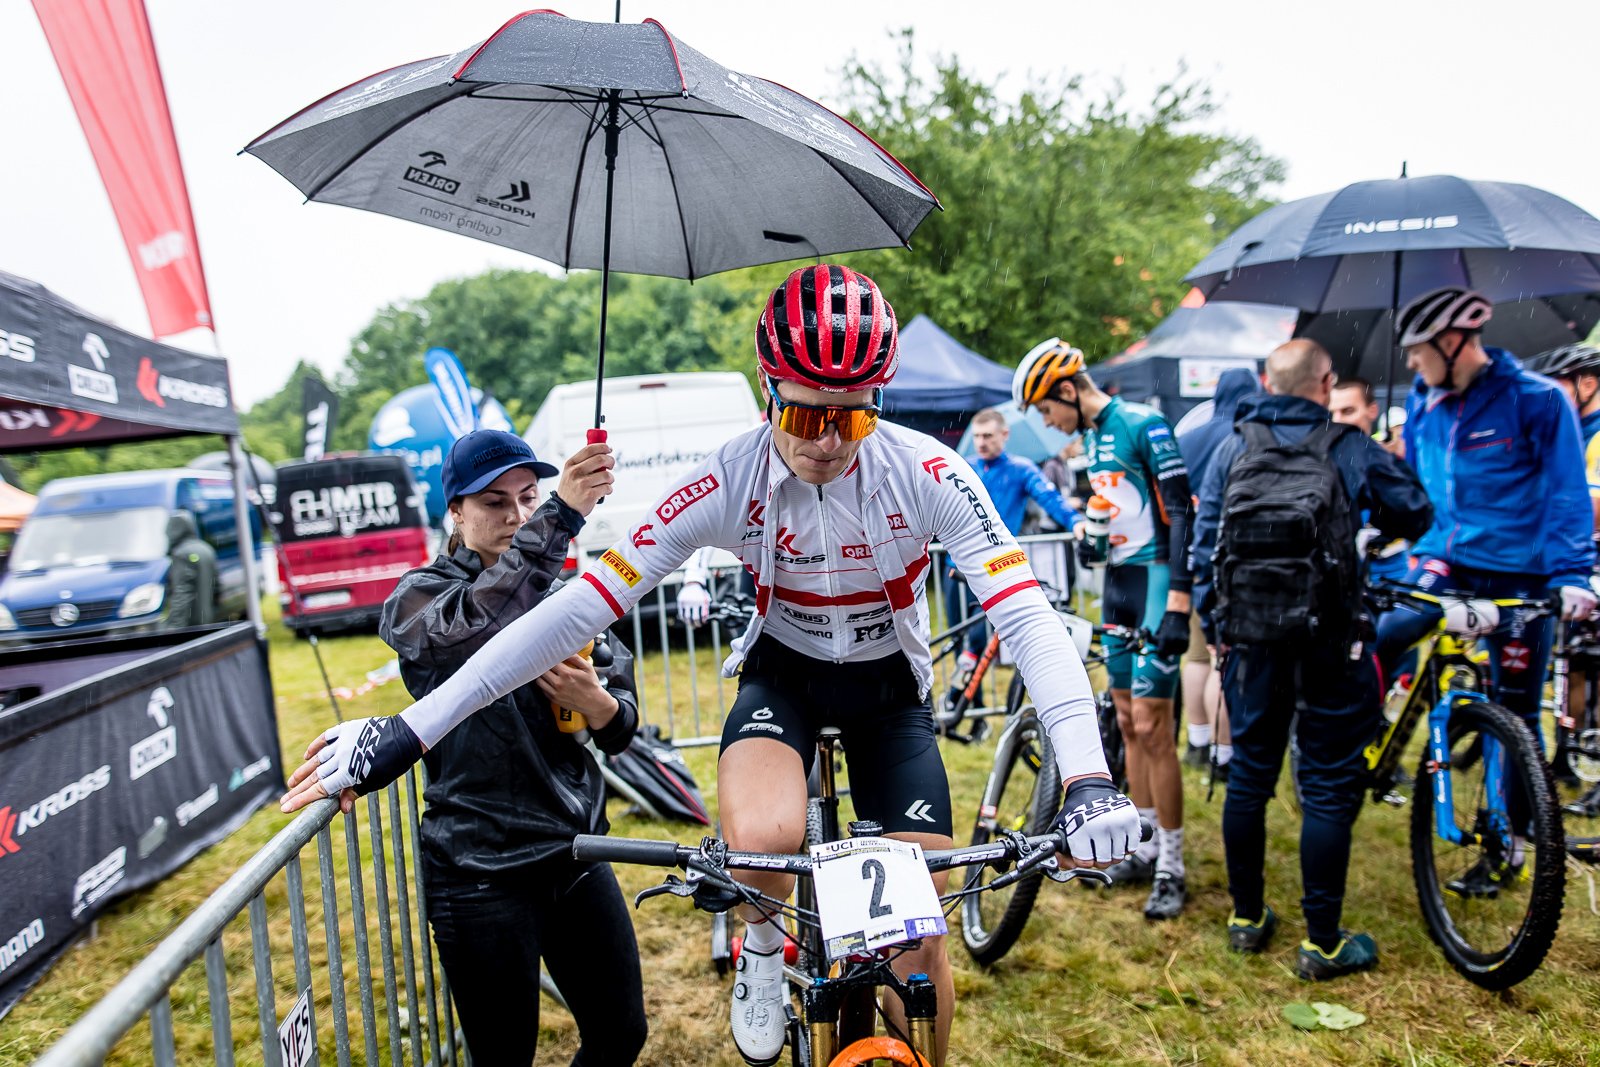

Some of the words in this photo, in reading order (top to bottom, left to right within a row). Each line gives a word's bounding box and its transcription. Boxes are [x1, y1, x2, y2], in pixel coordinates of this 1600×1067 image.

[1344, 215, 1459, 235] INESIS
[330, 481, 397, 512] MTB
[660, 478, 715, 519] ORLEN
[945, 472, 1003, 546] KROSS
[603, 550, 638, 583] PIRELLI
[782, 605, 826, 624] ABUS
[17, 765, 111, 836] KROSS
[830, 841, 853, 852] UCI
[861, 858, 893, 919] 2
[914, 919, 938, 935] EM
